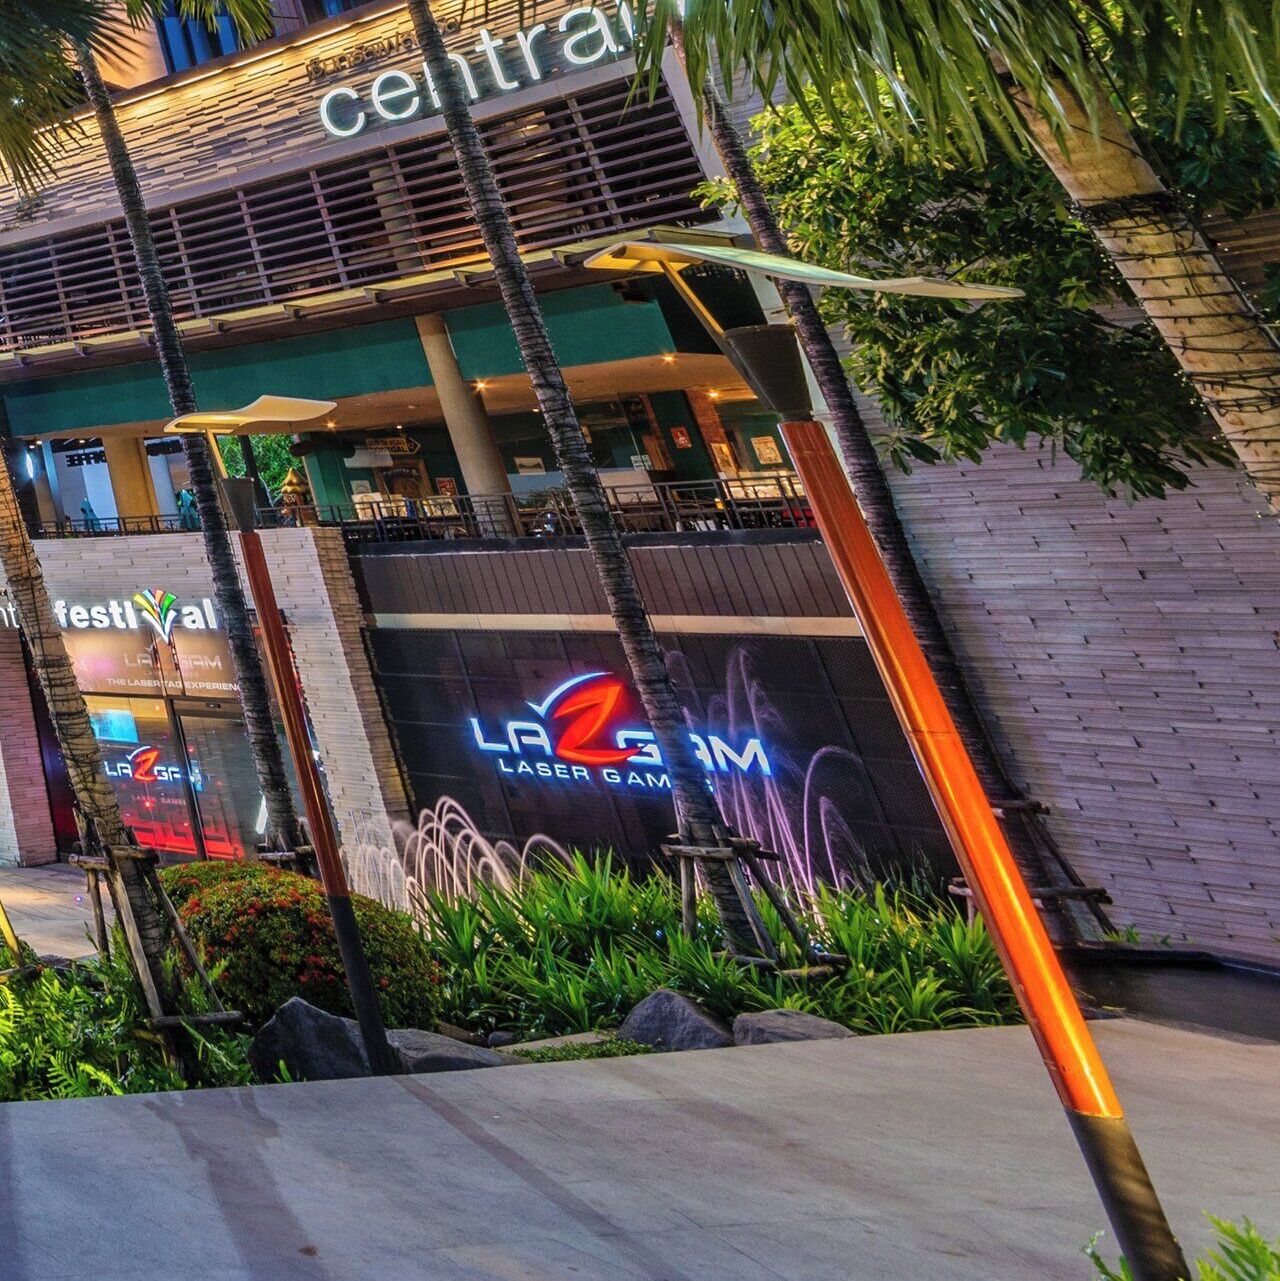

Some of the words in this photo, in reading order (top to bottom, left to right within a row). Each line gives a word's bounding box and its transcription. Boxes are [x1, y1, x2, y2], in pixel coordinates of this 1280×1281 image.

[54, 590, 218, 644] festival
[107, 677, 127, 686] THE
[128, 679, 160, 688] LASER
[498, 758, 591, 781] LASER
[602, 769, 714, 793] GAM
